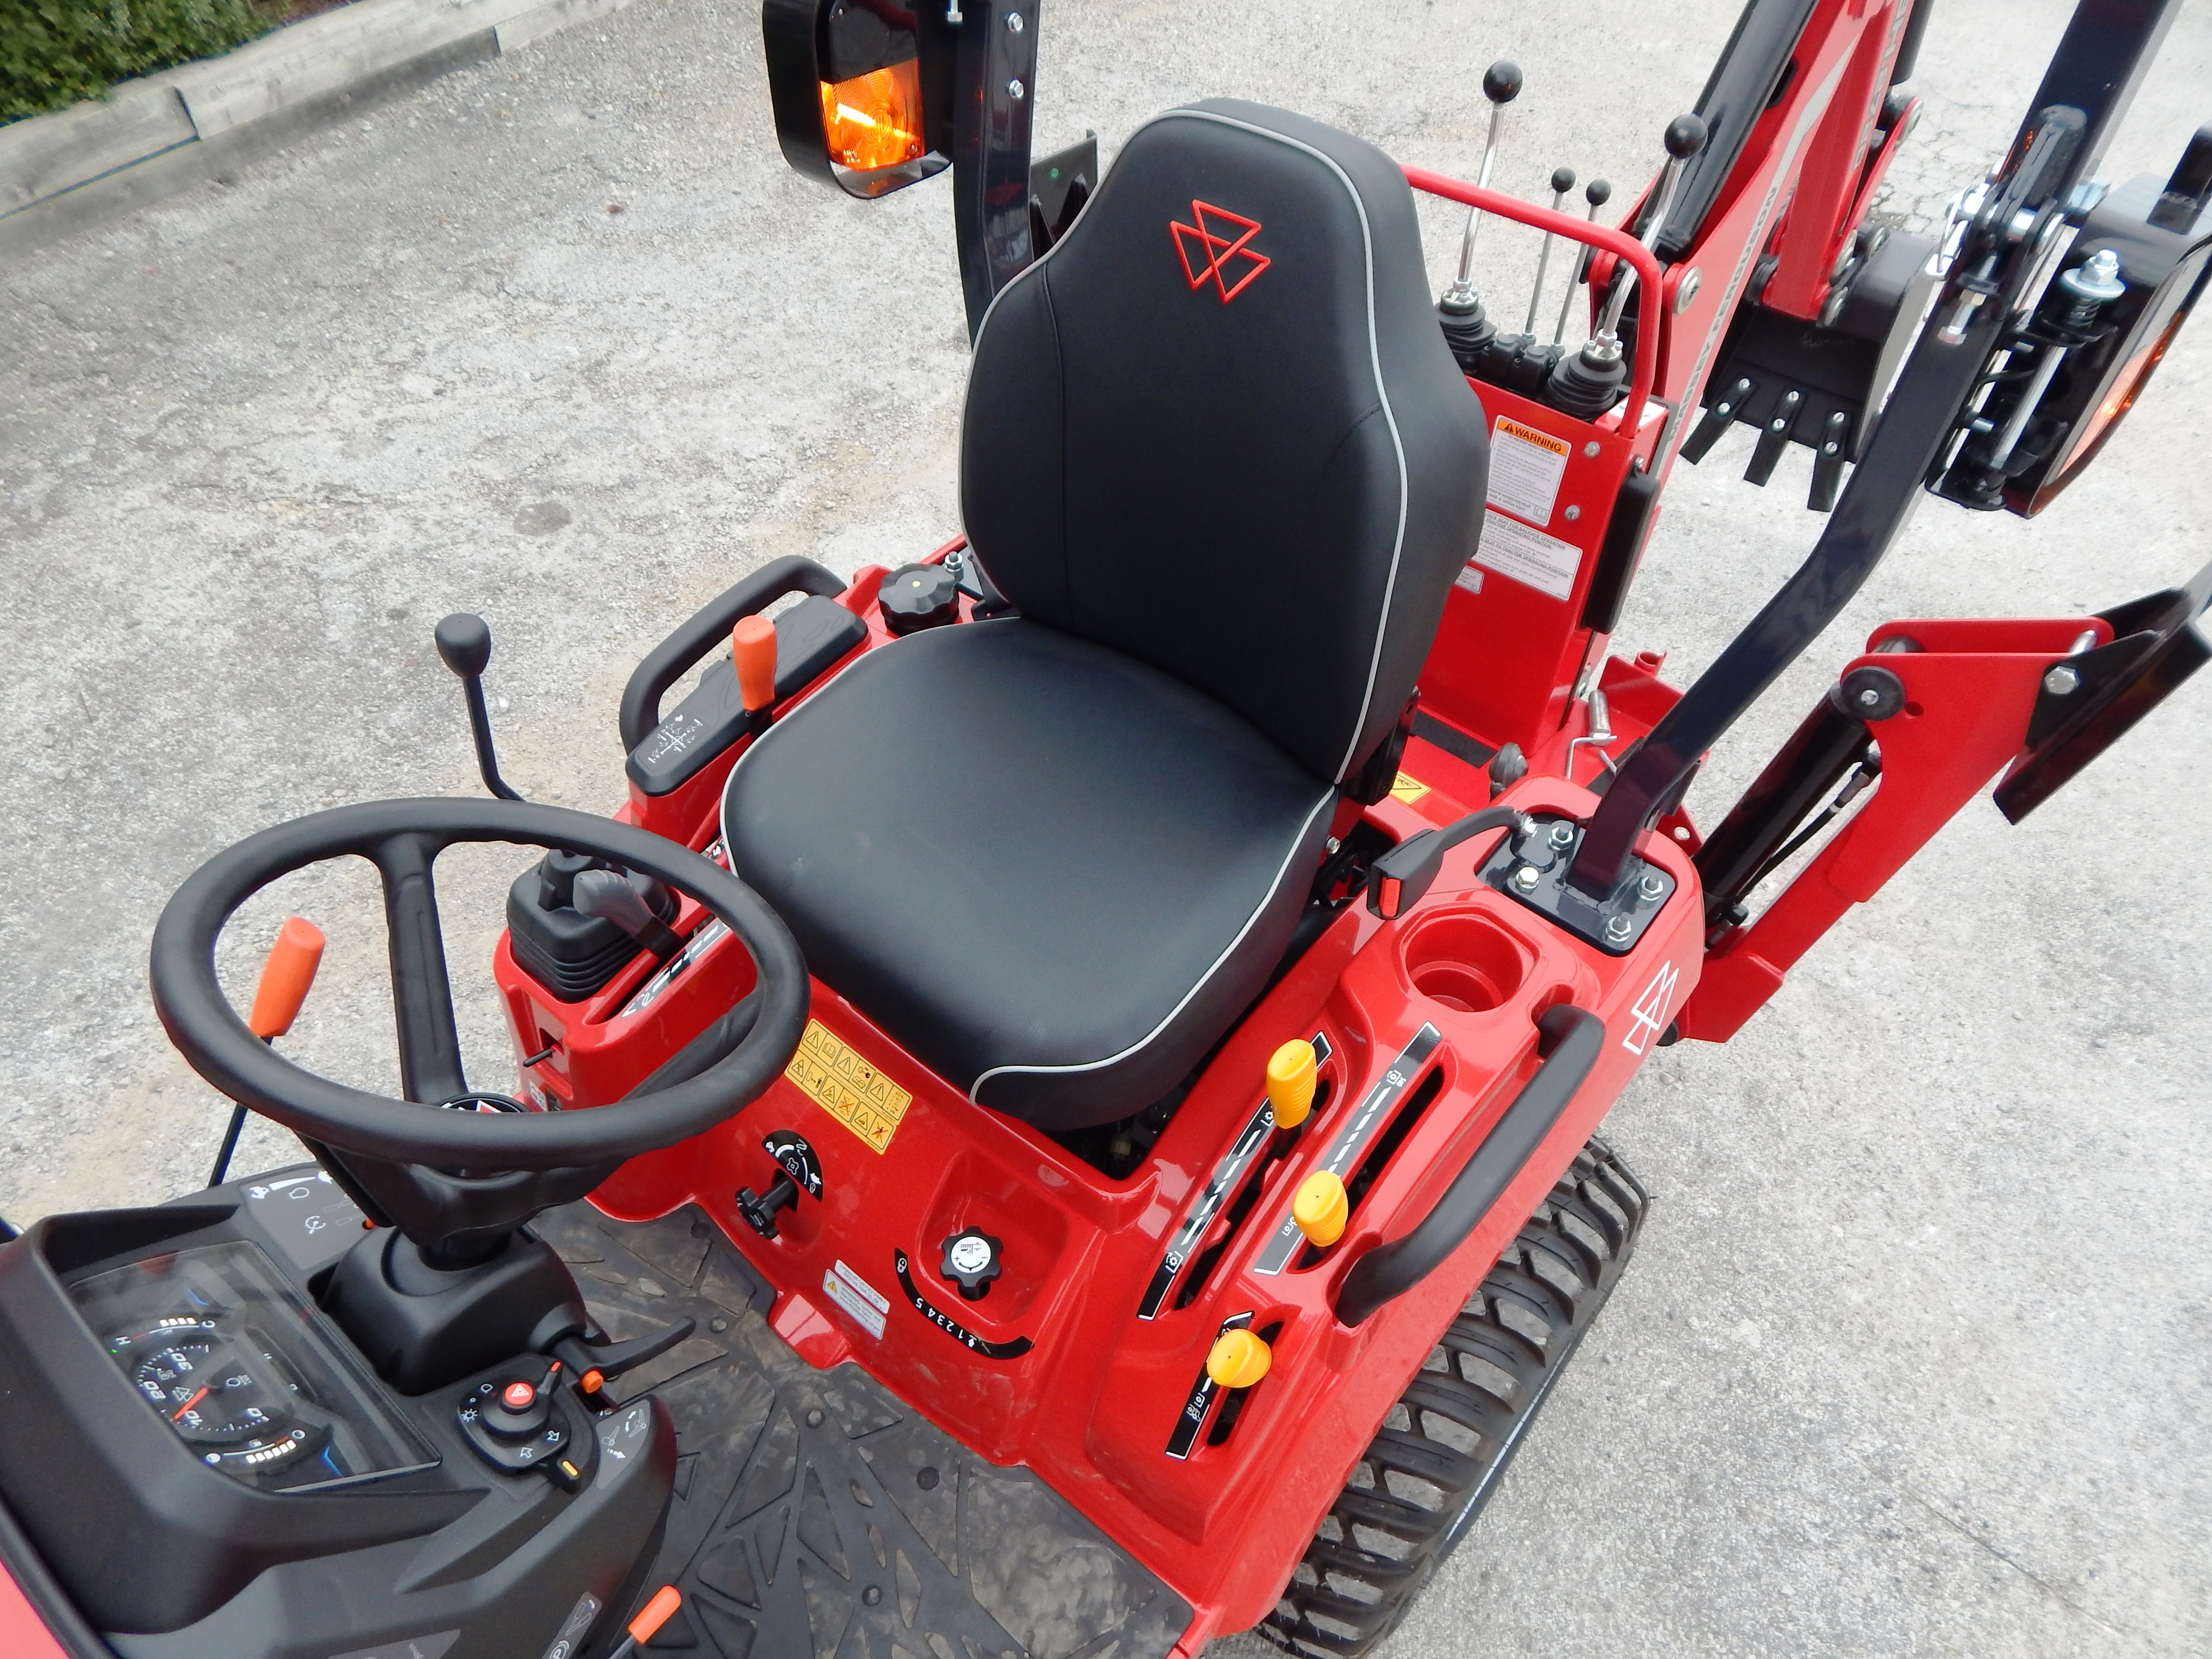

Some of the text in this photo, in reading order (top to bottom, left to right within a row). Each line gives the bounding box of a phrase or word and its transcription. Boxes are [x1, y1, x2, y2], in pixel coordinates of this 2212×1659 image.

[1668, 187, 1777, 441] MASSEY FERGUSON
[1515, 426, 1562, 452] WARNING
[915, 1298, 924, 1309] 5
[927, 1308, 936, 1317] 4
[937, 1315, 945, 1325] 3
[946, 1321, 954, 1332] 2
[958, 1329, 963, 1339] 1
[115, 1336, 132, 1345] H
[171, 1352, 193, 1370] 30
[143, 1381, 167, 1399] 20
[184, 1409, 203, 1425] 10
